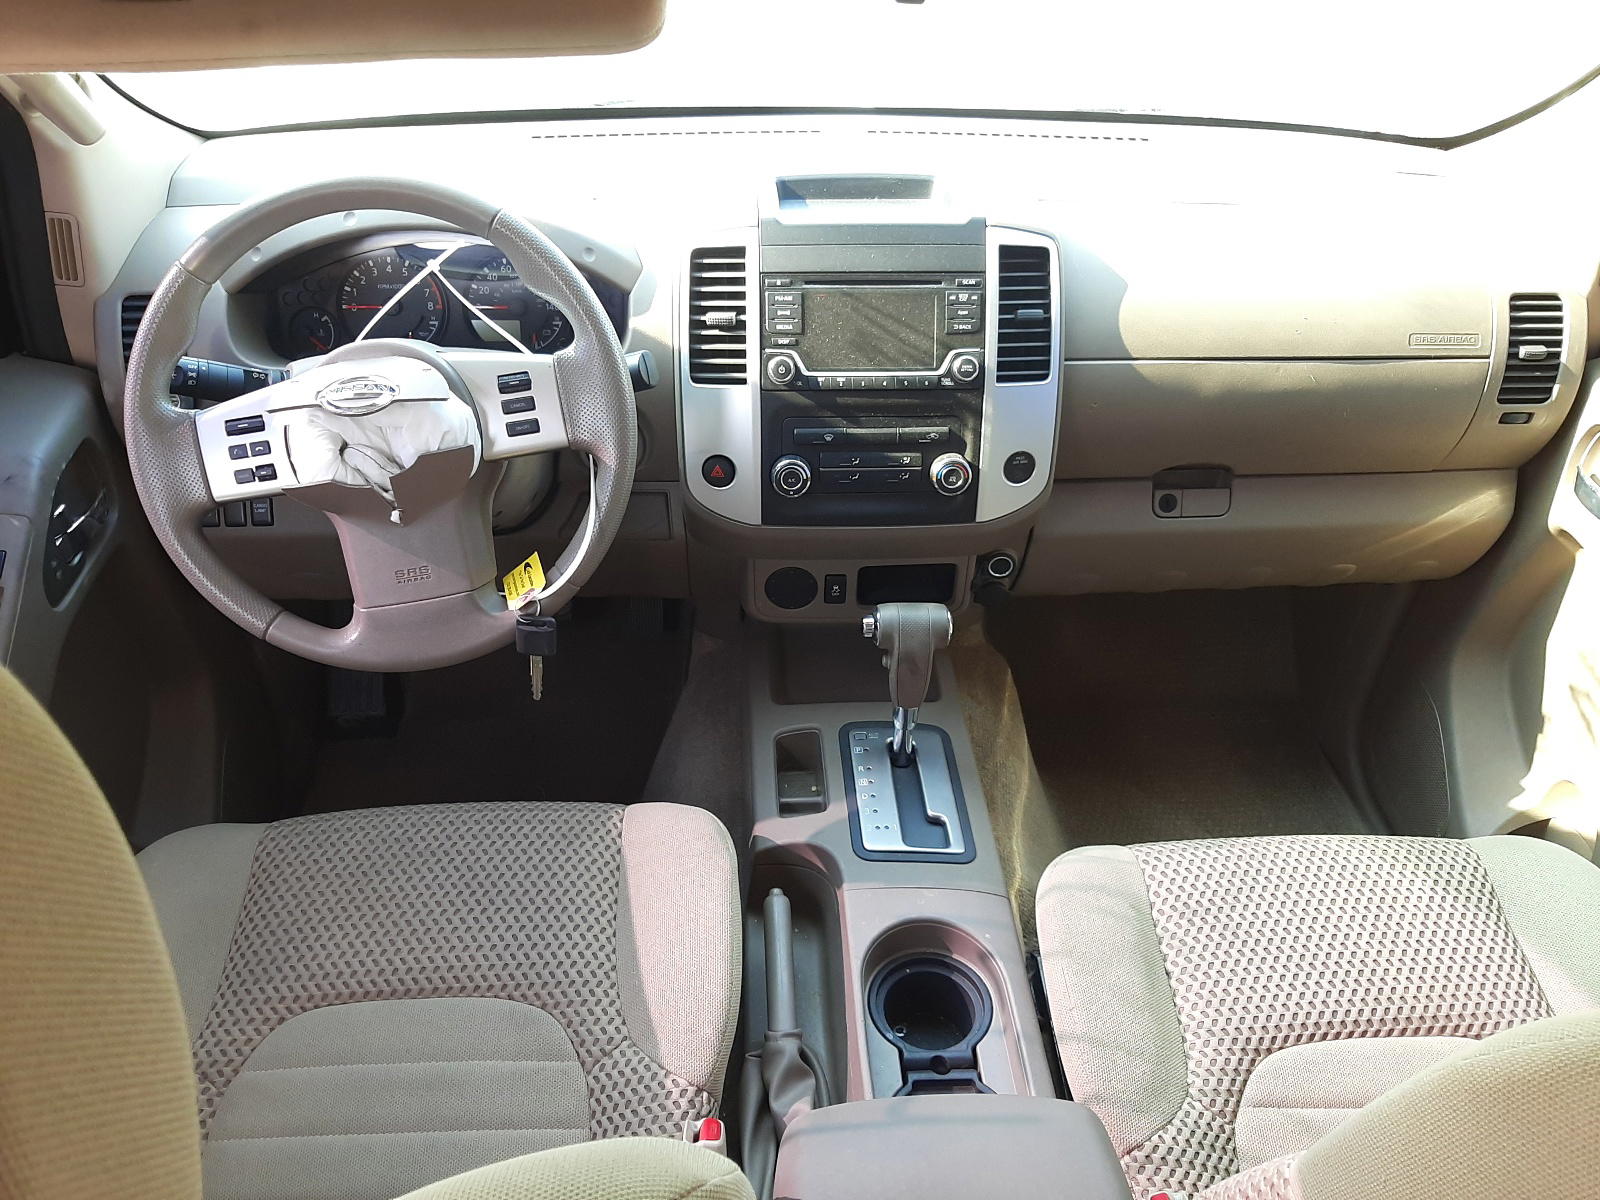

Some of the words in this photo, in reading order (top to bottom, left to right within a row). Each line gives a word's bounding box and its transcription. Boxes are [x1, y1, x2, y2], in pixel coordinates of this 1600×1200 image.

[372, 268, 378, 276] 3
[386, 265, 392, 273] 4
[402, 268, 408, 276] 5
[500, 265, 512, 273] 60
[360, 276, 366, 284] 2
[487, 273, 498, 281] 40
[424, 289, 430, 297] 7
[478, 286, 490, 294] 20
[427, 302, 434, 311] 8
